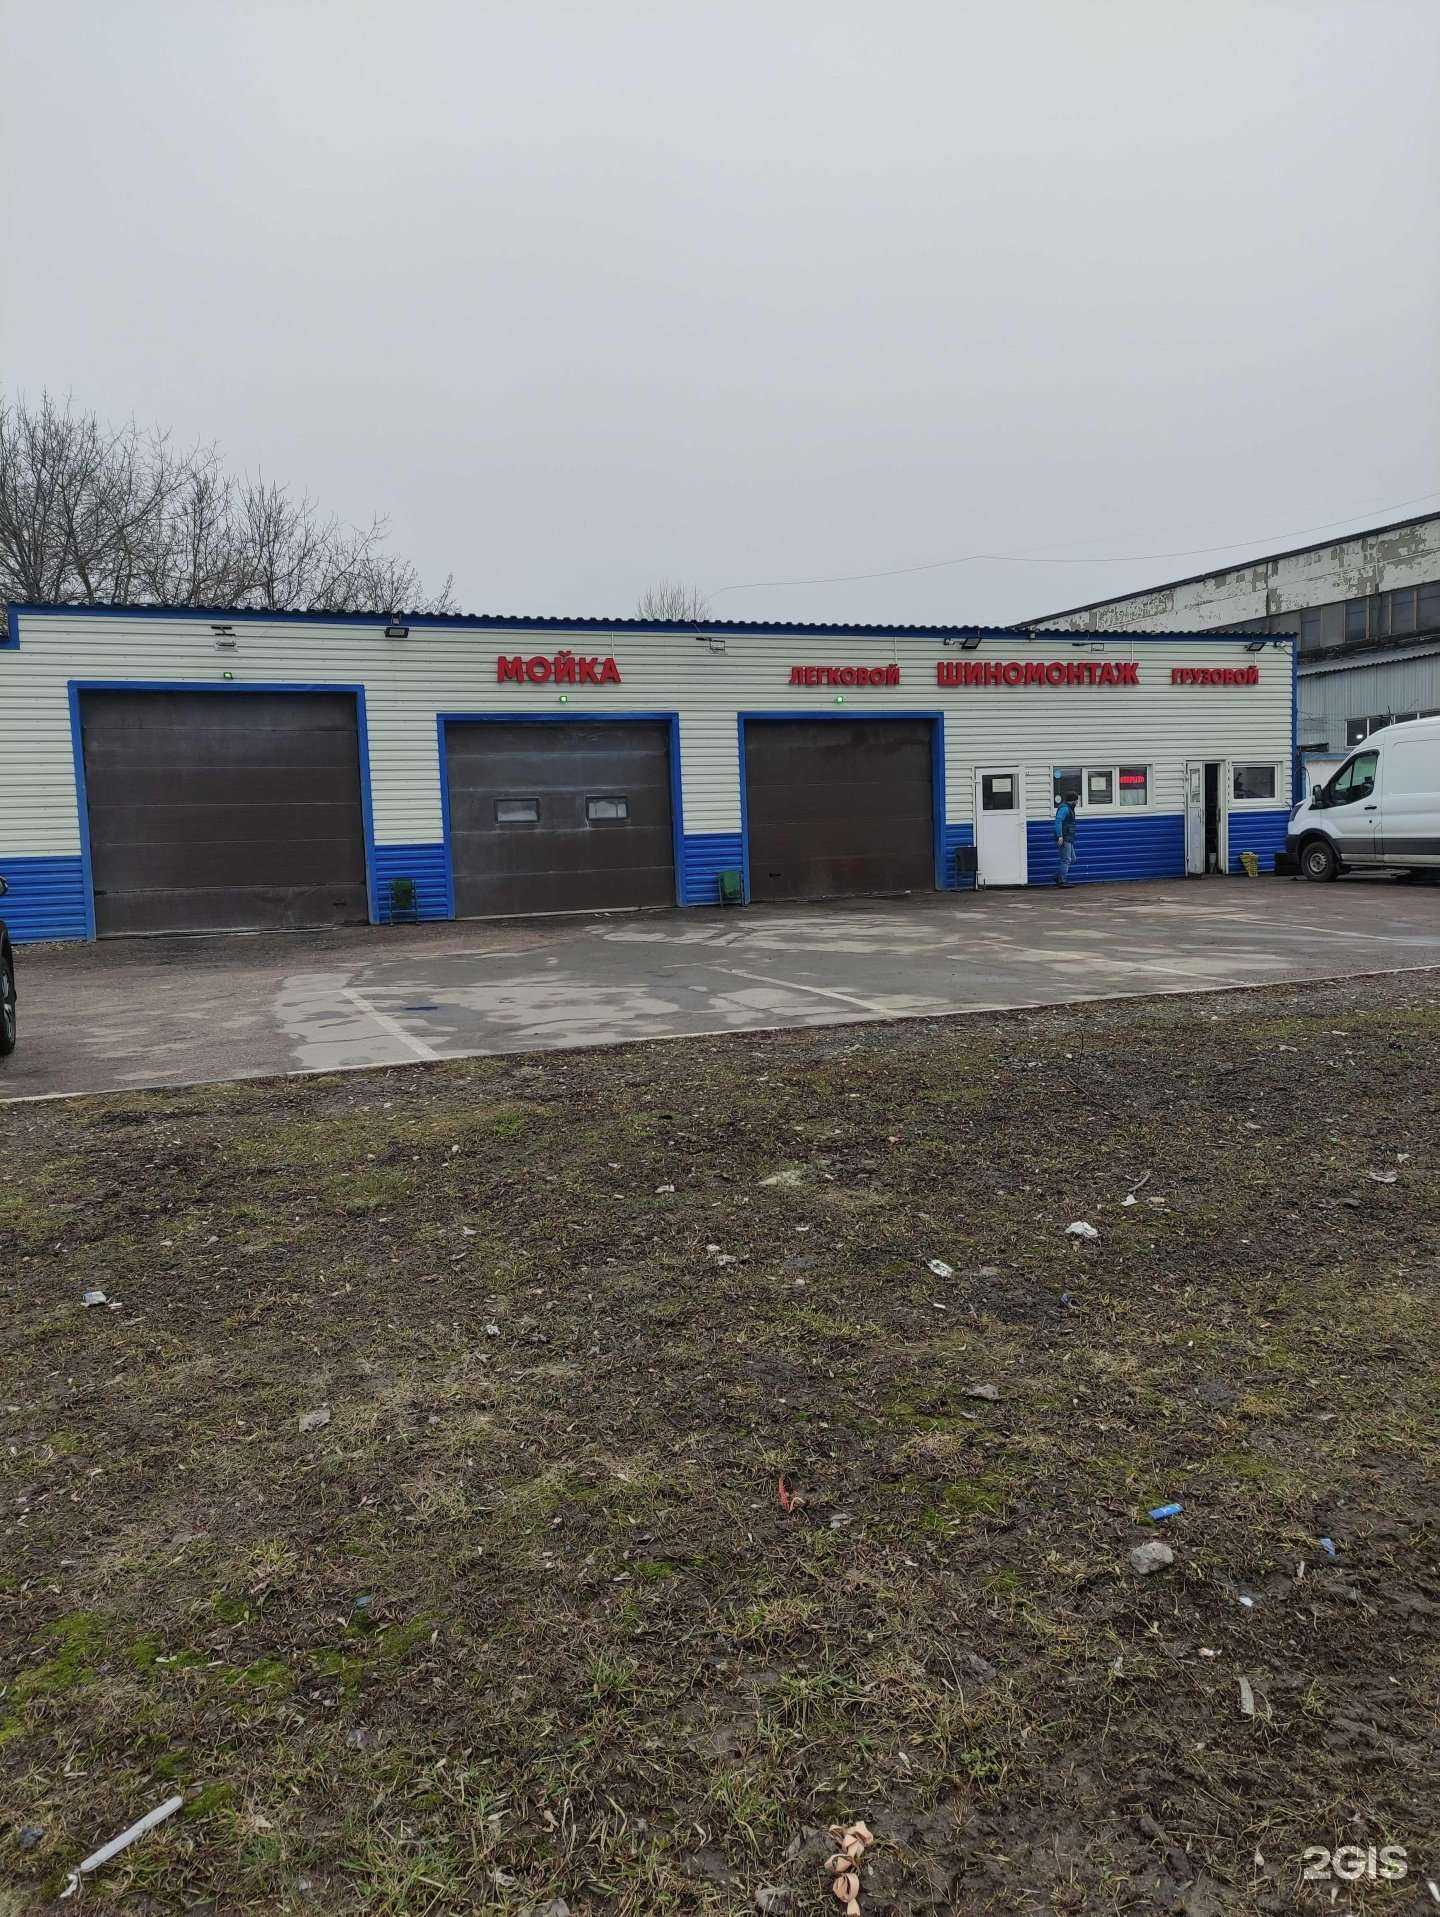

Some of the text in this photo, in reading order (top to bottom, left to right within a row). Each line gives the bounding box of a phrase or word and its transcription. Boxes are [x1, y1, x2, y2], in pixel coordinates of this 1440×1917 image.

[497, 651, 621, 684] МОЙКА
[790, 661, 1259, 686] ЛЕГКОВОЙ ШИНОМОНТАЖ ГРУЗОВОЙ
